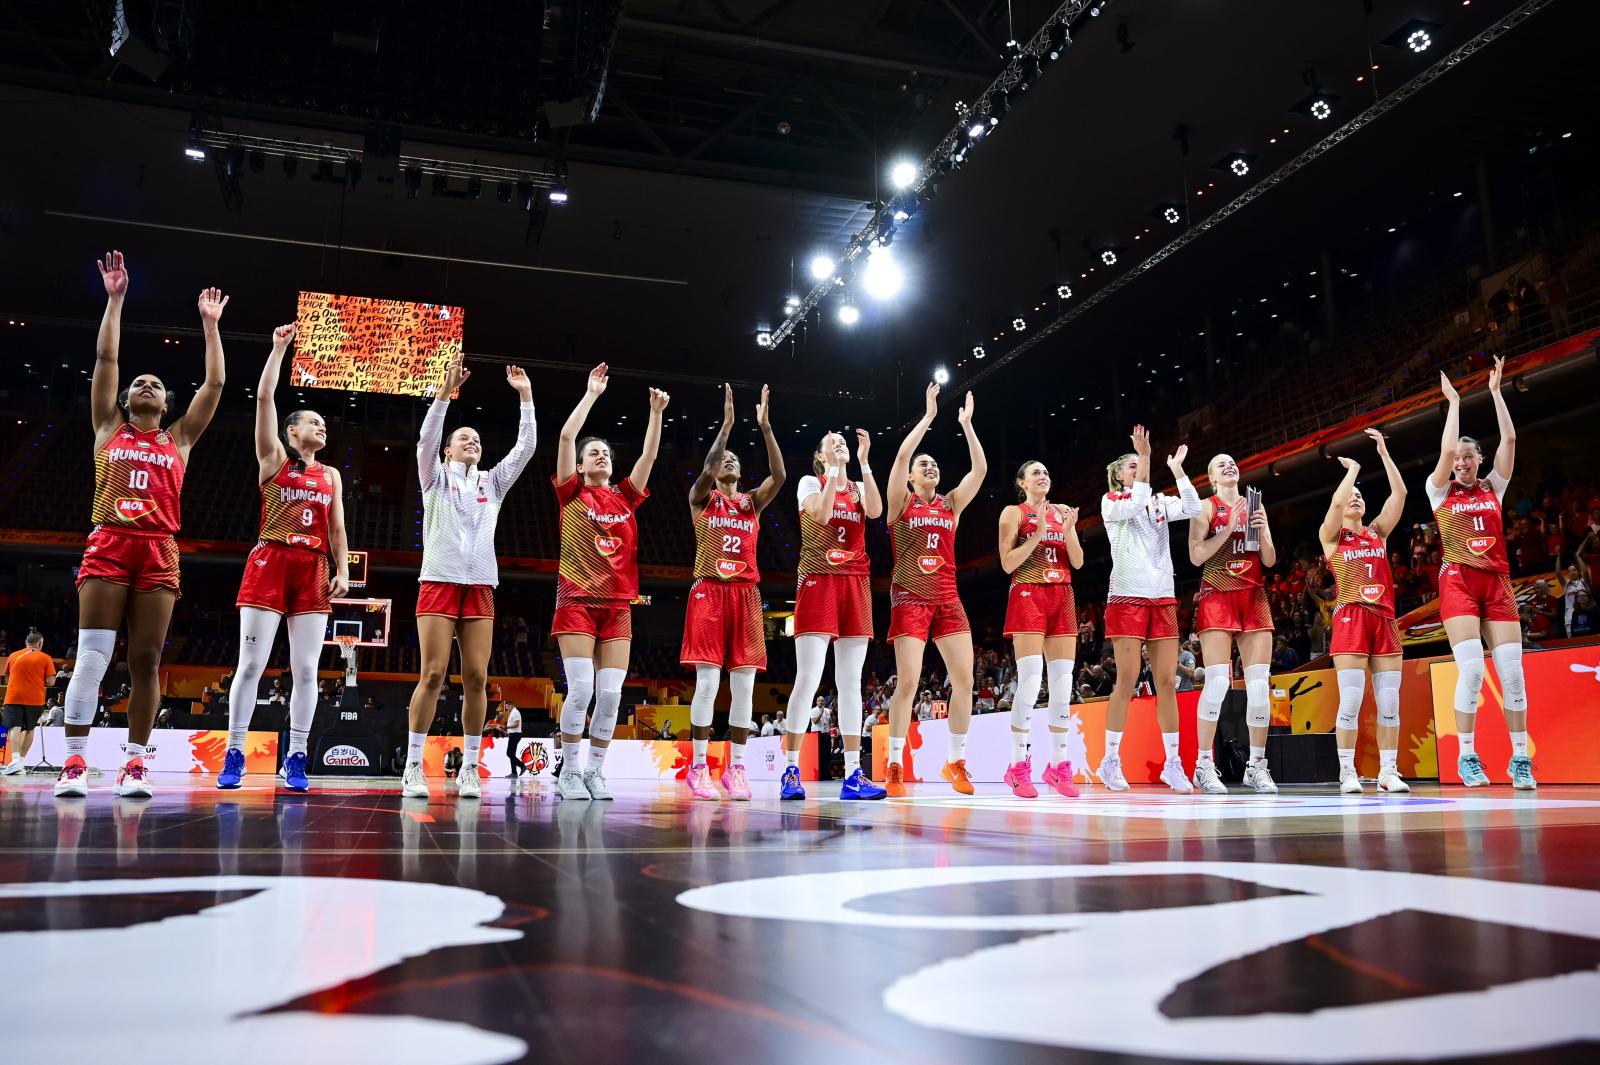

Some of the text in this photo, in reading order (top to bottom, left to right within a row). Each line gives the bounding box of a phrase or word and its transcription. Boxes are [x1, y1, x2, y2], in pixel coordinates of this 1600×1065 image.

[108, 447, 174, 470] HUNGARY
[129, 469, 149, 490] 10
[120, 500, 144, 511] MOL
[1451, 500, 1496, 515] HUNGARY
[302, 508, 313, 527] 9
[708, 516, 754, 533] HUNGARY
[908, 516, 953, 531] HUNGARY
[1472, 515, 1485, 531] 11
[291, 535, 311, 546] MOL
[837, 526, 846, 543] 2
[926, 532, 940, 549] 13
[722, 534, 741, 553] 22
[1232, 538, 1245, 554] 14
[1471, 539, 1488, 548] MOL
[922, 558, 937, 566] MOL
[1045, 547, 1058, 563] 21
[1342, 546, 1385, 563] HUNGARY
[720, 561, 736, 571] MOL
[1364, 563, 1373, 578] 7
[1363, 587, 1379, 595] MOL
[340, 711, 358, 721] FIBA
